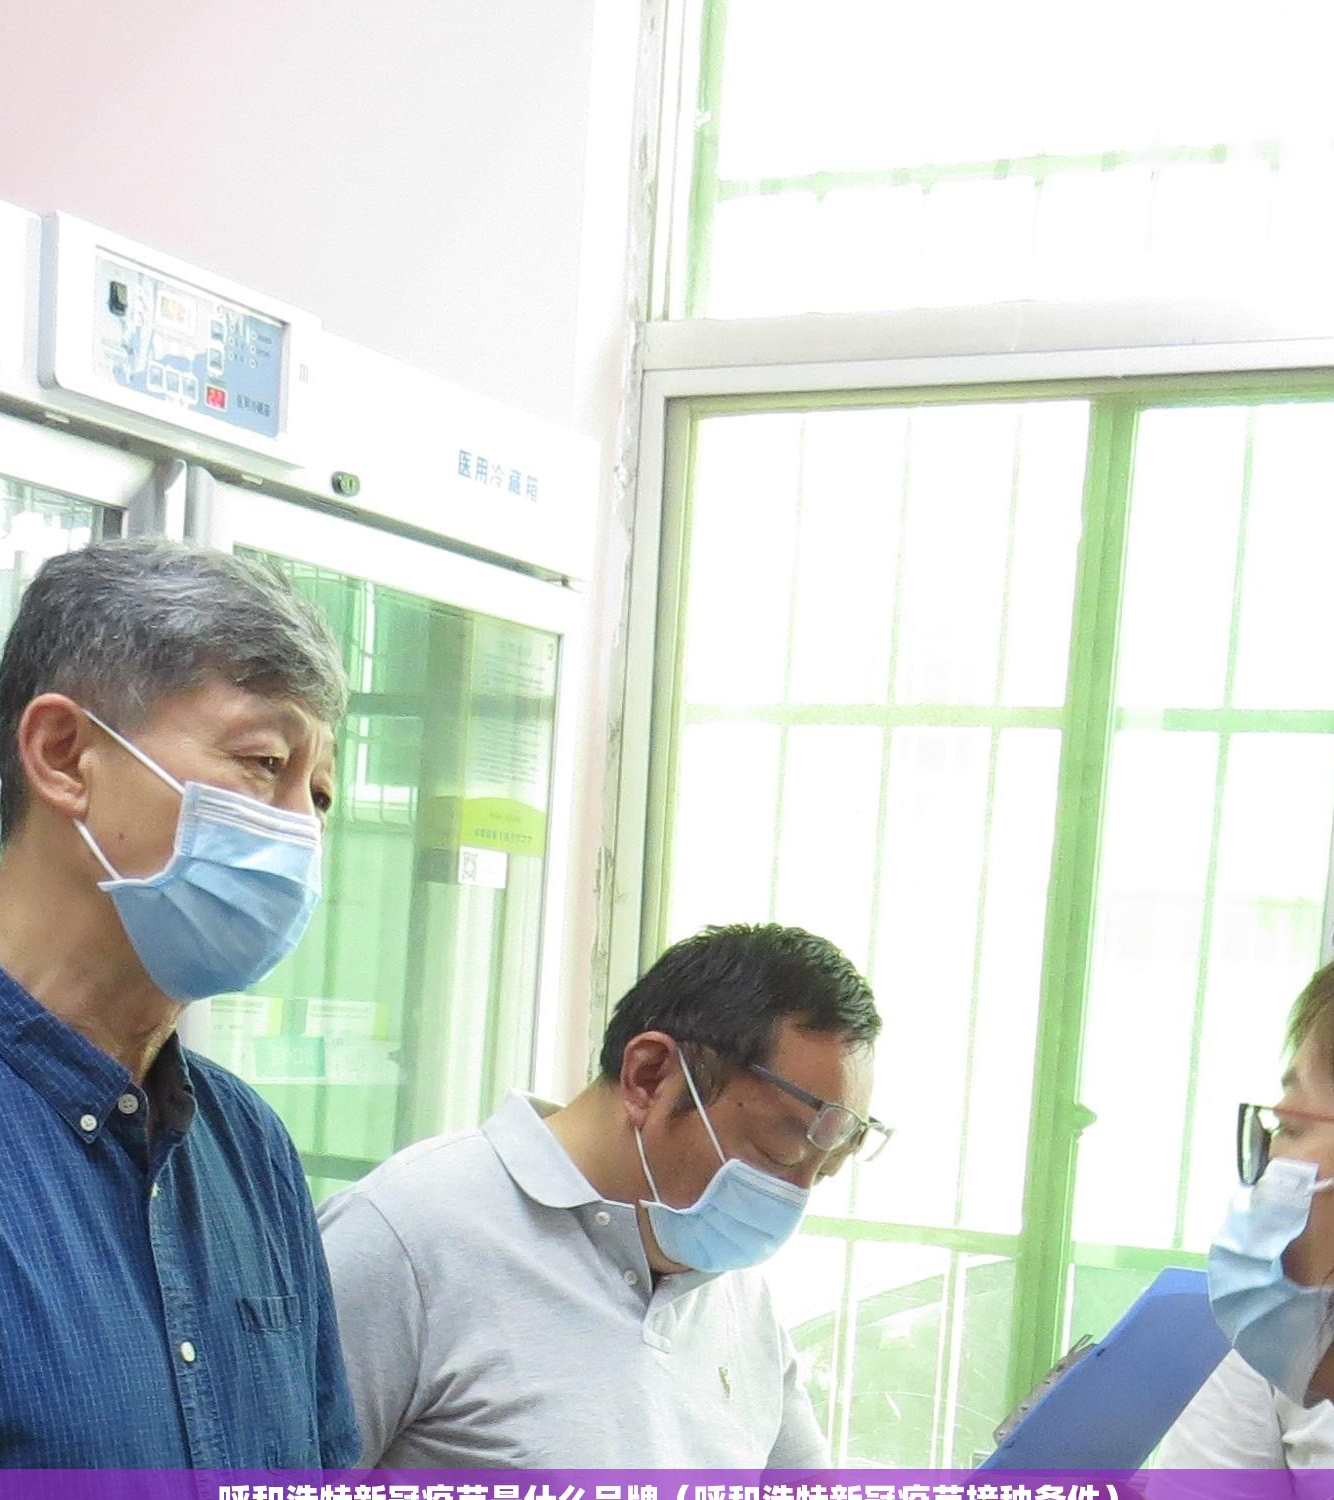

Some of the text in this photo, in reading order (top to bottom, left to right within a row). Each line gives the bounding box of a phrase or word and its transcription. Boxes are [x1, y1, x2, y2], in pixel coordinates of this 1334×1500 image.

[458, 449, 538, 502] 医用冷藏箱
